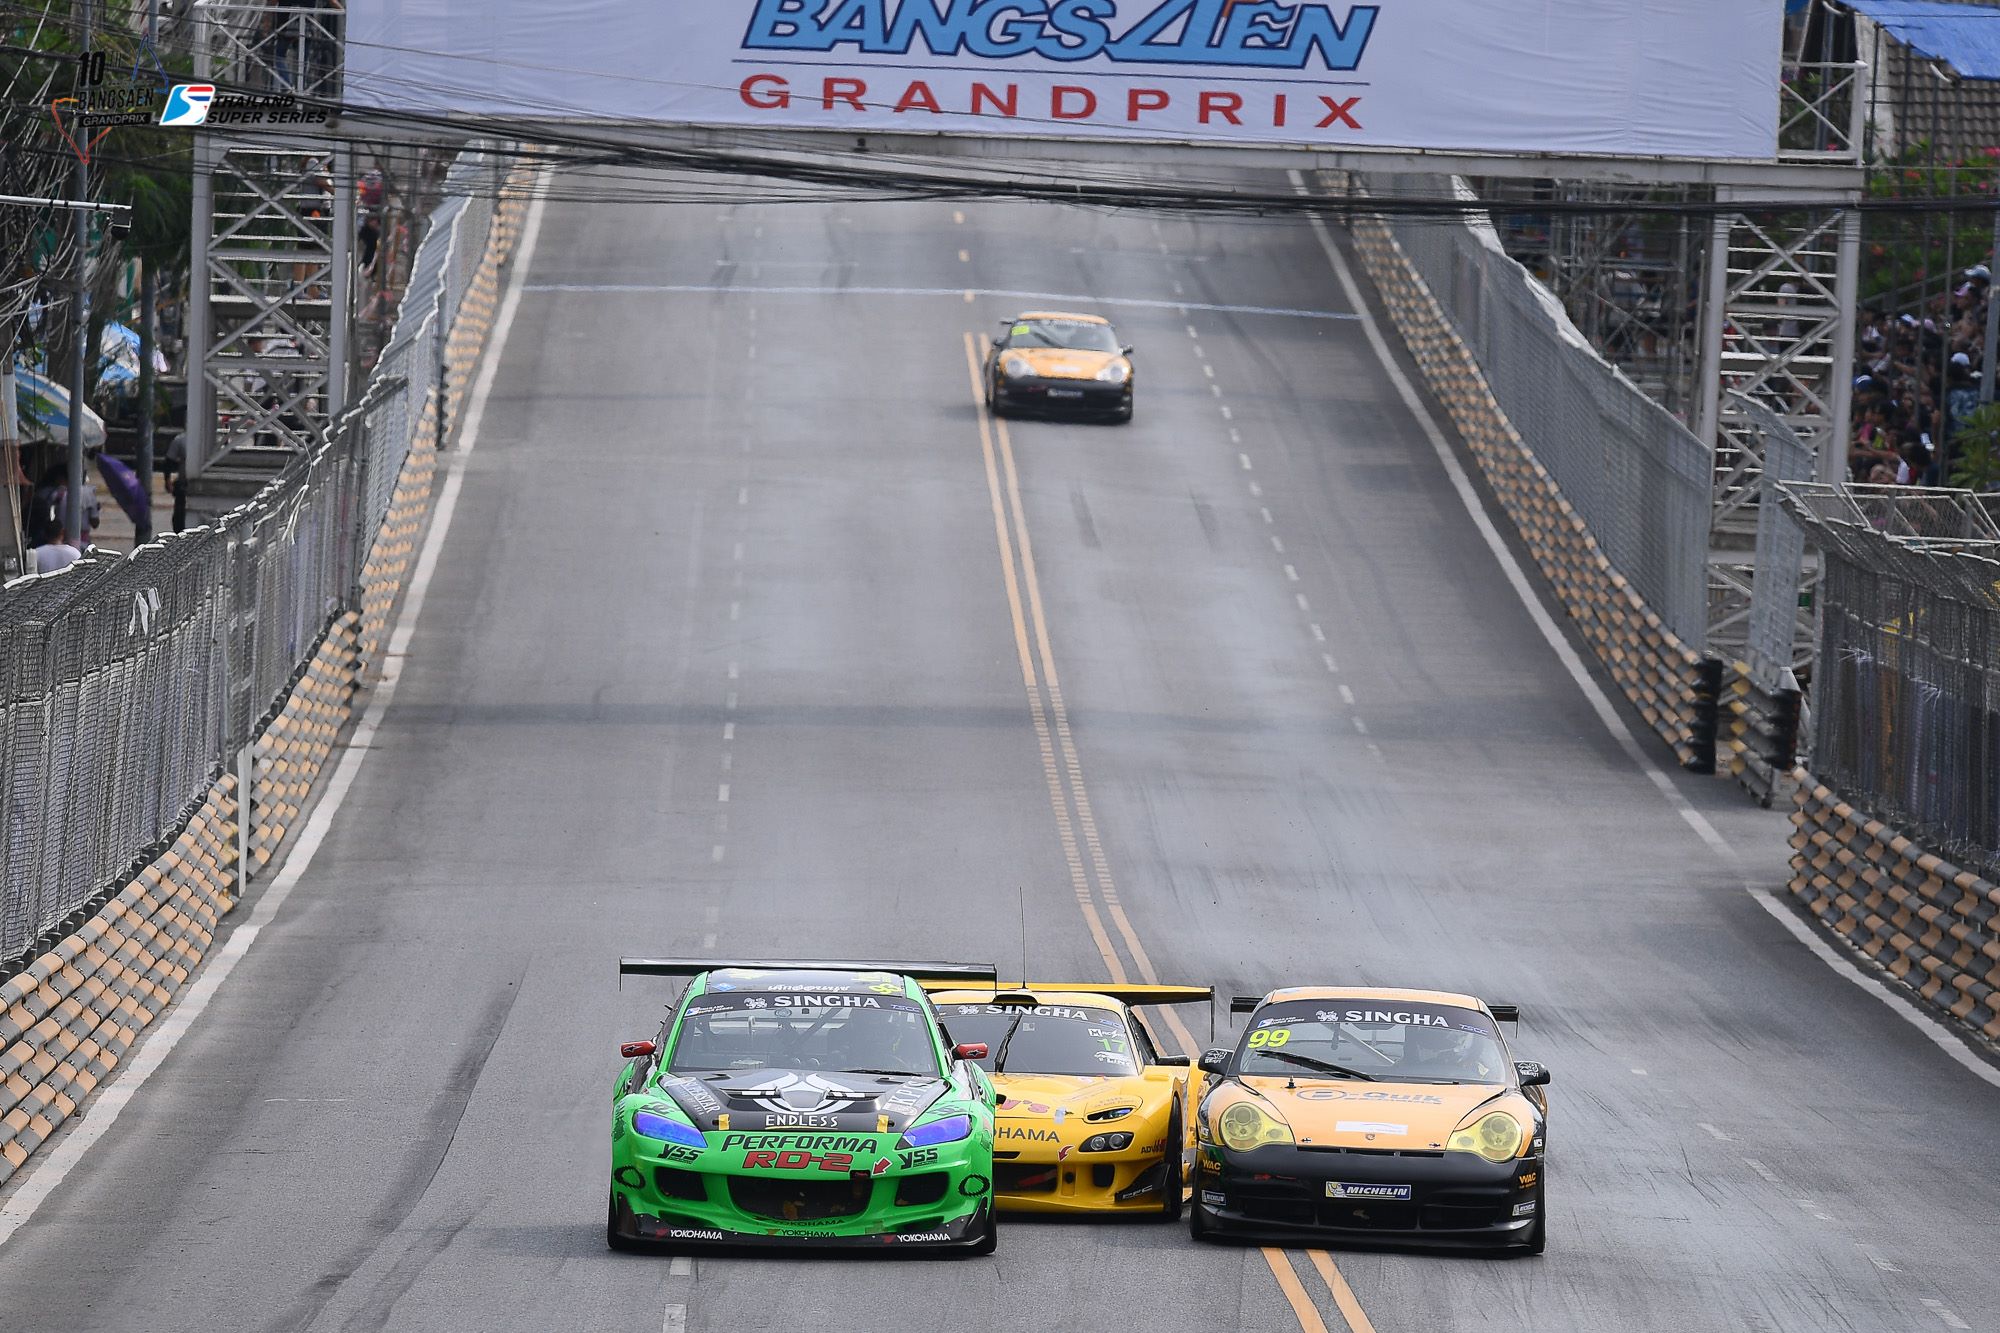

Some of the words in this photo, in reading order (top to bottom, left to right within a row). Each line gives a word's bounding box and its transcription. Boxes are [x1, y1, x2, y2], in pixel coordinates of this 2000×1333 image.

[774, 995, 881, 1010] SINGHA
[985, 1004, 1089, 1022] SINGHA
[1344, 1010, 1450, 1028] SINGHA
[1097, 1038, 1126, 1053] 17
[1247, 1028, 1291, 1049] 99
[765, 1114, 839, 1127] ENDLESS
[993, 1126, 1060, 1143] HAMA
[720, 1134, 879, 1154] PERFORMA
[742, 1150, 854, 1172] RD-2
[1345, 1185, 1409, 1197] MICHELIN
[670, 1228, 724, 1241] YOKOHAMA
[781, 1228, 838, 1238] YOKOHAMA
[896, 1232, 952, 1243] YOKOHAMA
